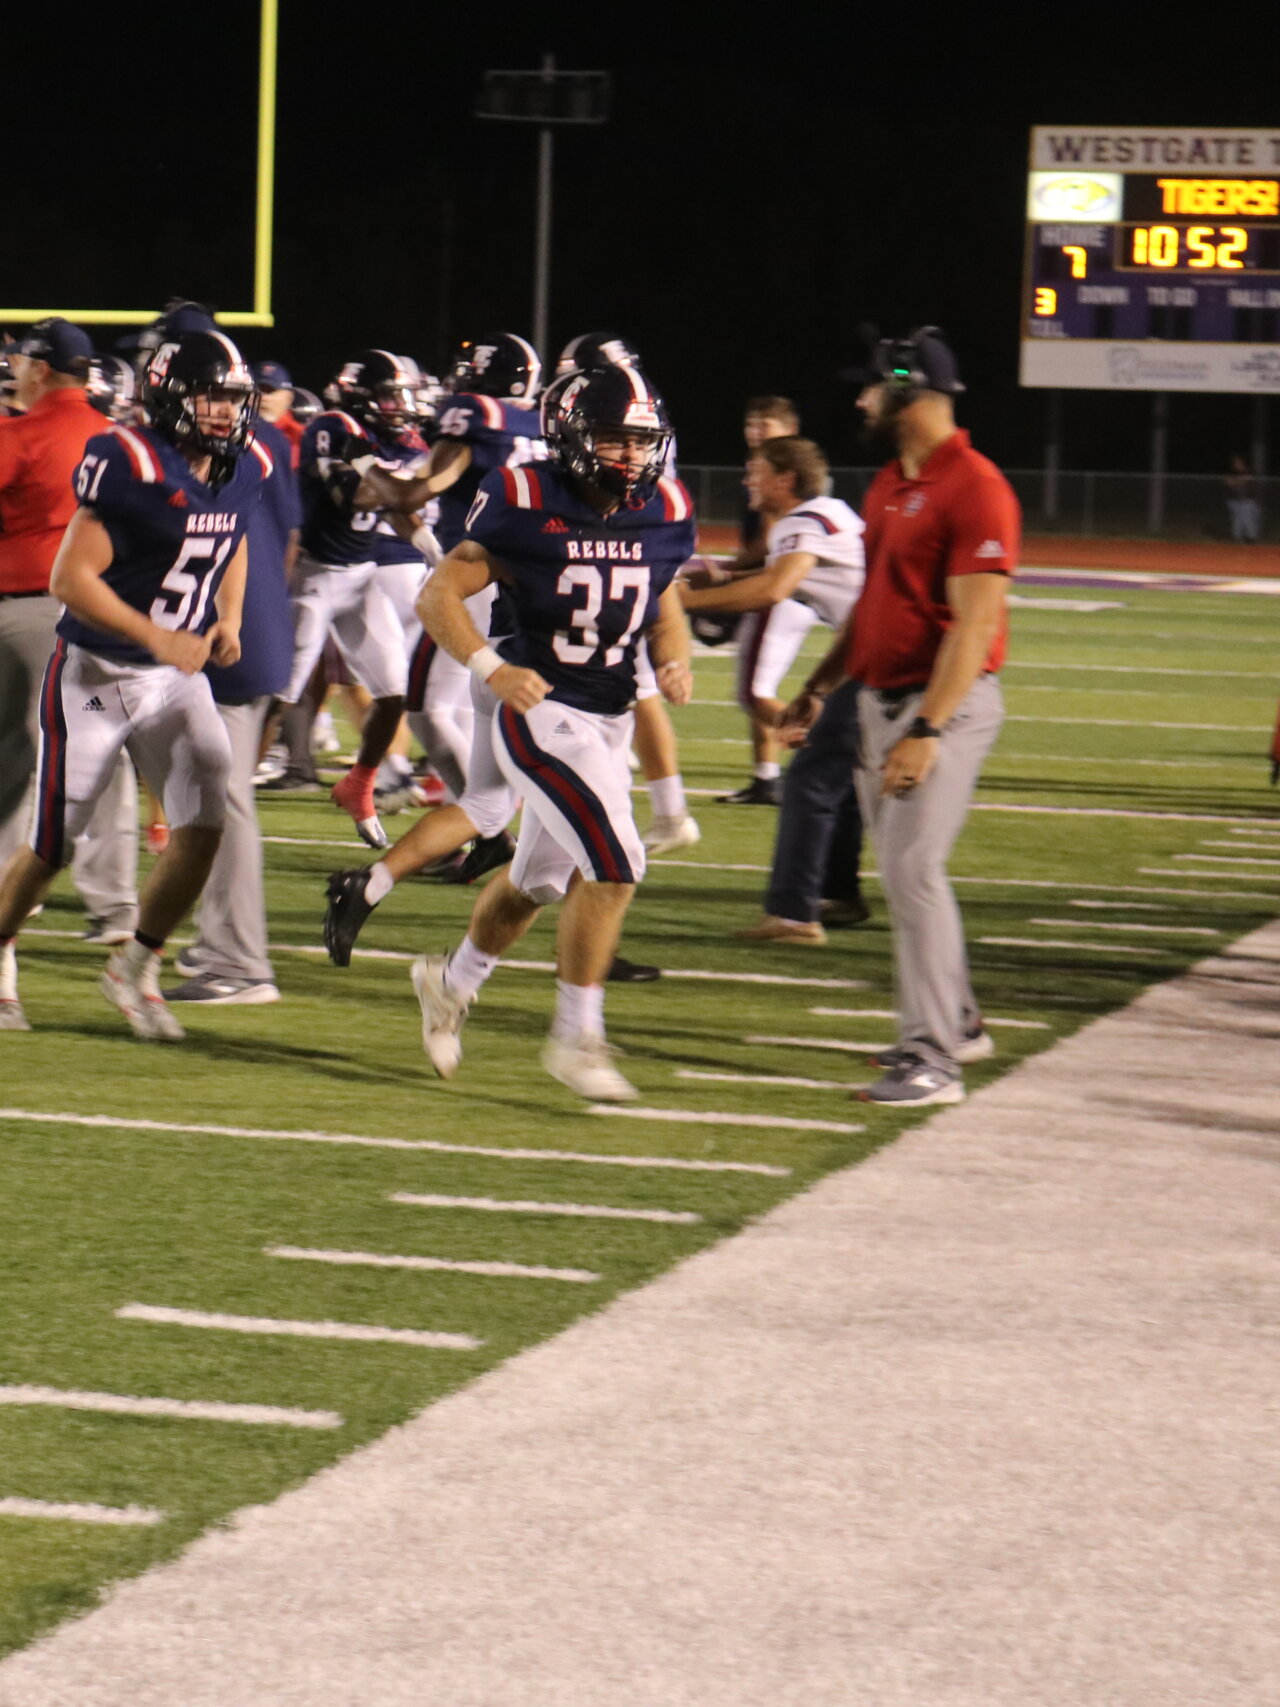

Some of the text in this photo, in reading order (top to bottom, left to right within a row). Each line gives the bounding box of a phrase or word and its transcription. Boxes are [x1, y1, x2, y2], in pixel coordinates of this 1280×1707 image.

[1047, 135, 1256, 166] WESTGATE
[1062, 245, 1087, 279] 7
[1034, 287, 1057, 315] 3
[76, 455, 109, 500] 51
[185, 513, 238, 533] REBELS
[465, 488, 490, 532] 7
[567, 540, 643, 560] REBELS
[150, 537, 232, 631] 51
[552, 565, 651, 667] 37
